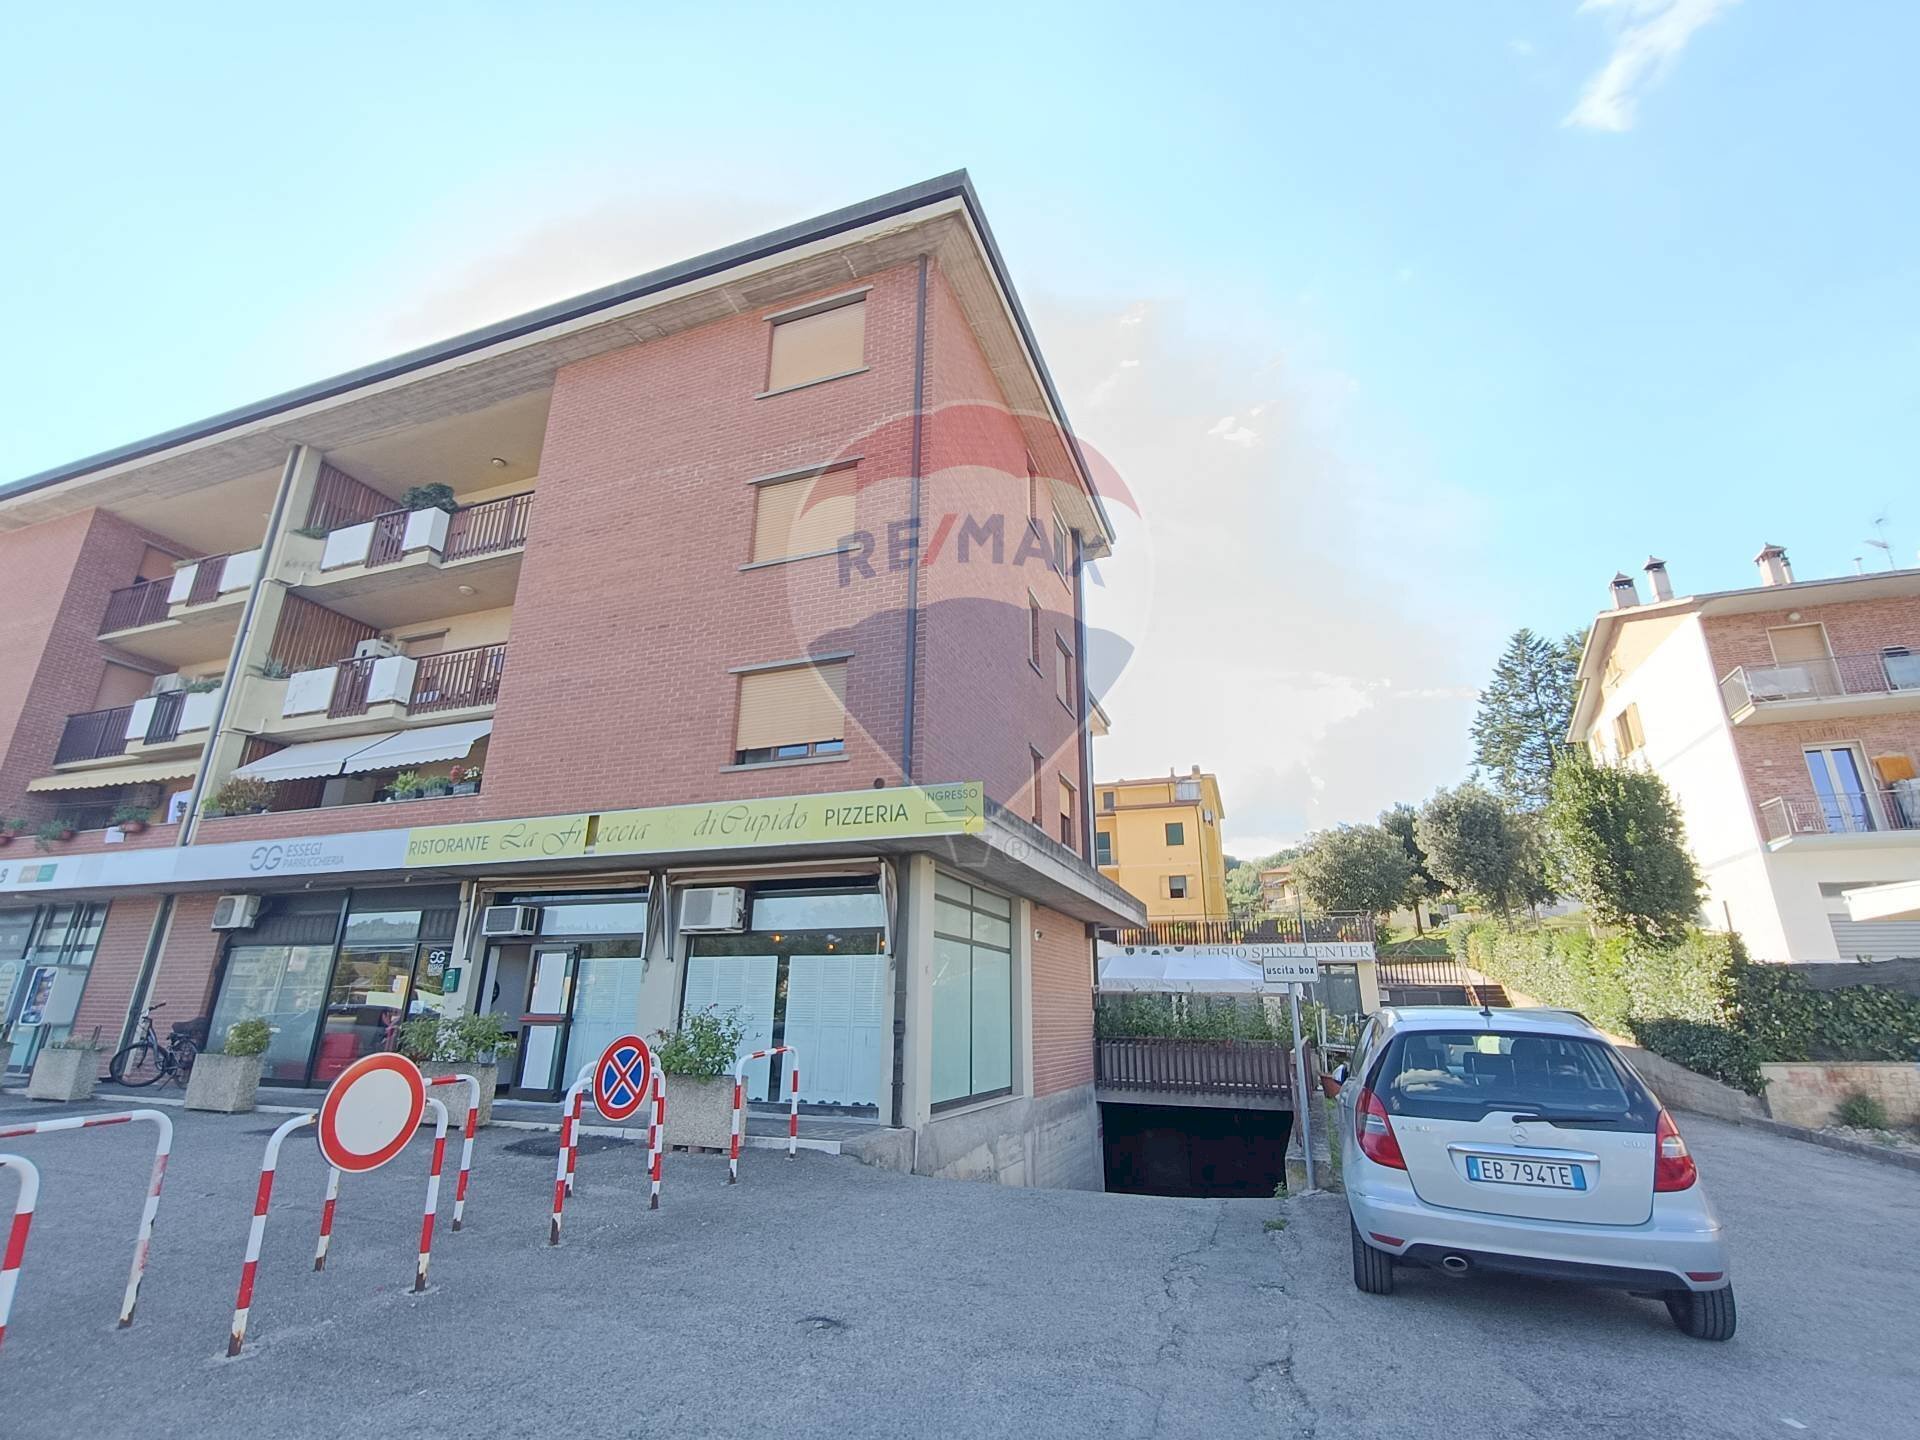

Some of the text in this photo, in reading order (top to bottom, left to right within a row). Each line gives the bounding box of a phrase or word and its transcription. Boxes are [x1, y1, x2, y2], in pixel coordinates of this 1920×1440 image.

[925, 788, 978, 801] INGRESSO
[408, 835, 490, 856] RISTORANTE
[500, 823, 540, 850] La
[824, 803, 909, 826] PIZZERIA
[286, 842, 323, 857] ESSEGI
[1302, 945, 1371, 958] CENTER
[1266, 964, 1315, 975] uscita box
[1480, 1160, 1505, 1181] EB
